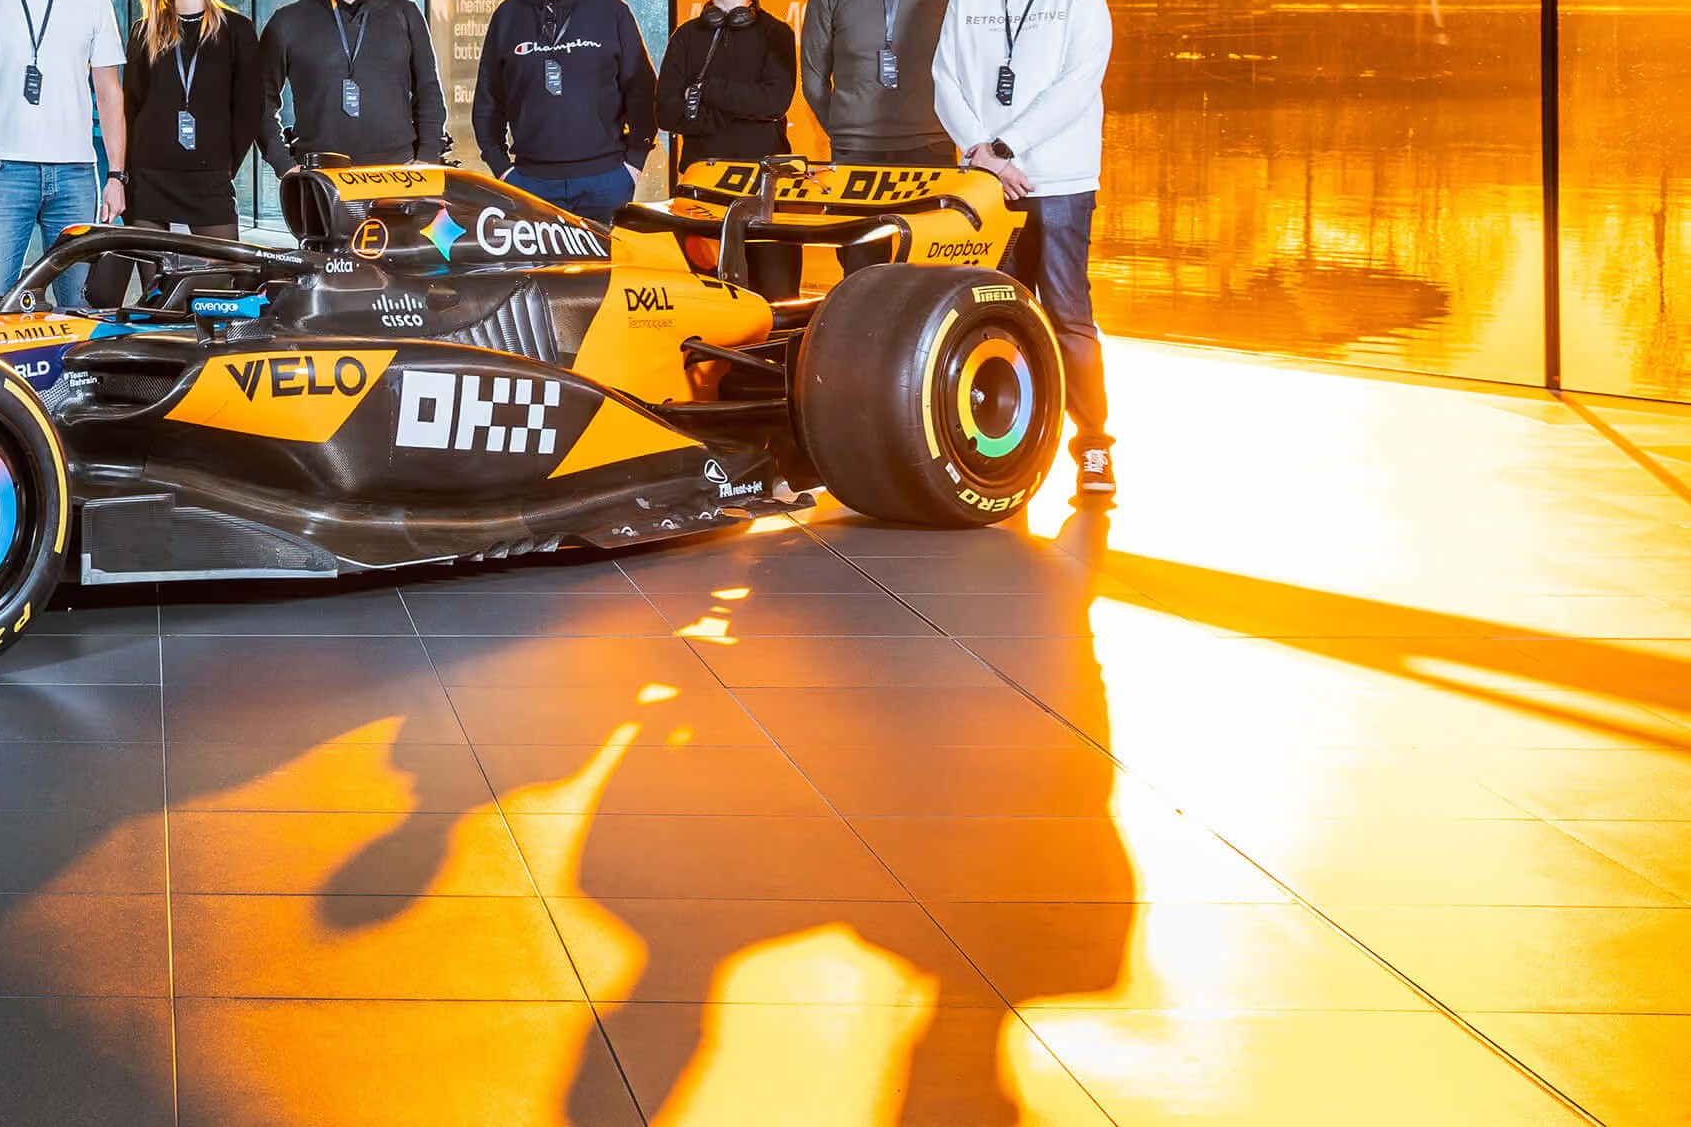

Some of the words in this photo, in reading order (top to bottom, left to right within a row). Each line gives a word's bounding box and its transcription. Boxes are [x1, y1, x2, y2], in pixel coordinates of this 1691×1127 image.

[454, 42, 473, 60] but
[514, 38, 602, 56] Champion
[454, 85, 475, 103] Bru
[338, 170, 427, 188] avenga
[840, 171, 942, 201] OKX
[476, 206, 608, 256] Gemini
[927, 240, 993, 260] Dropbox
[325, 258, 353, 273] okta
[624, 287, 674, 311] DELL
[971, 285, 1017, 303] PIRELLI
[194, 302, 239, 313] avenga
[382, 314, 423, 327] cisco
[15, 324, 74, 341] MILLE
[225, 356, 368, 402] VELO
[395, 370, 561, 455] OKX
[958, 488, 1026, 512] ZERO
[14, 601, 31, 632] P
